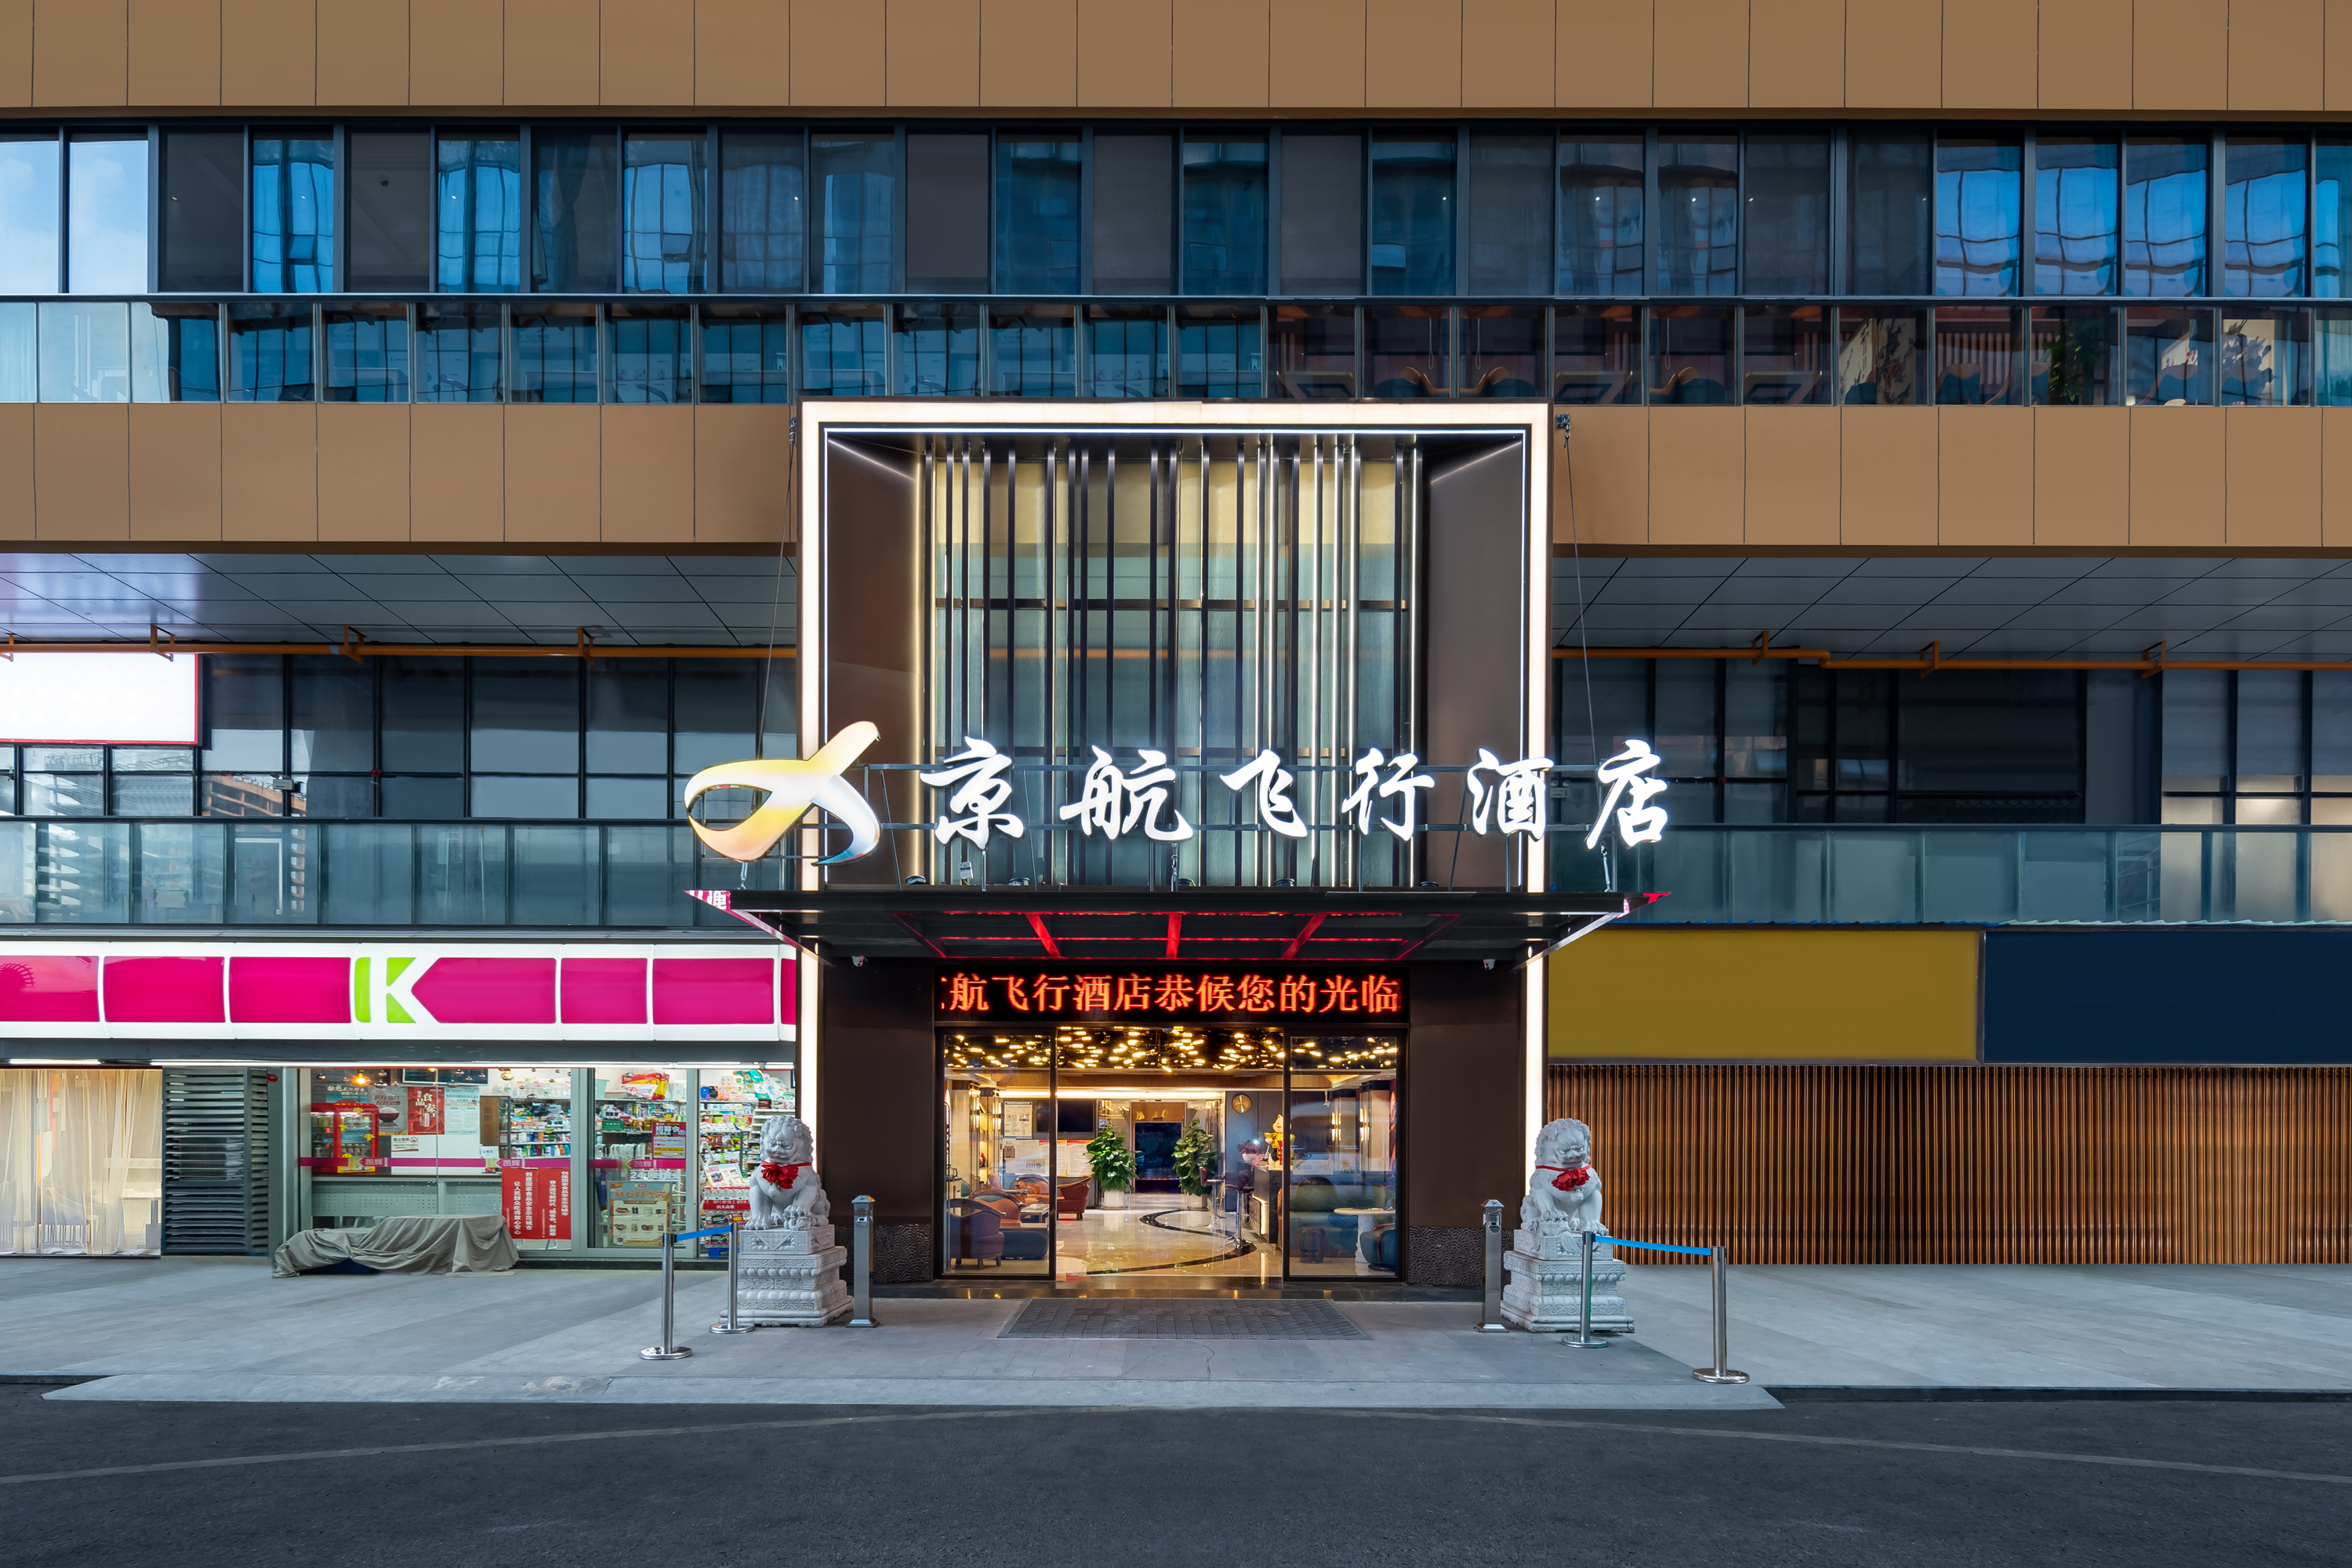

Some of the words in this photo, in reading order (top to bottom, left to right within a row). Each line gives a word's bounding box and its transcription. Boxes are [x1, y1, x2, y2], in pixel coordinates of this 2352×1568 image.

[920, 735, 1668, 850] 京航飞行酒店
[941, 972, 1399, 1013] 航飞行酒店恭候您的光临
